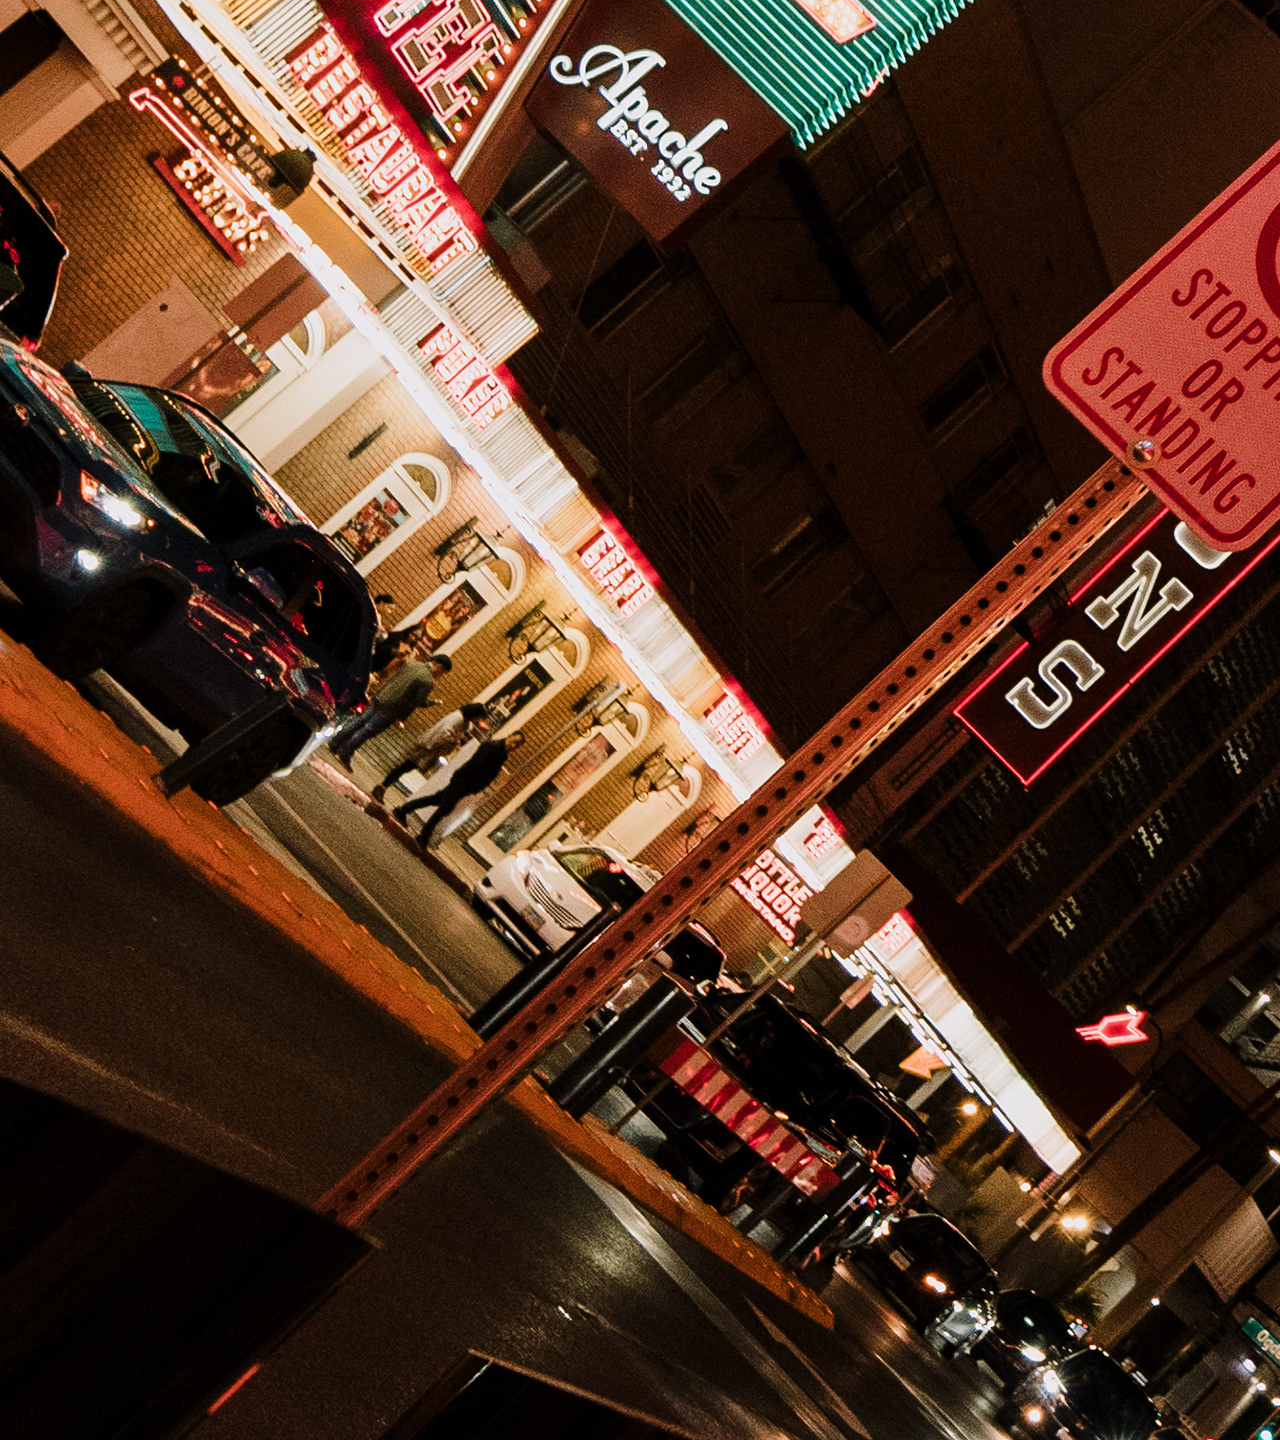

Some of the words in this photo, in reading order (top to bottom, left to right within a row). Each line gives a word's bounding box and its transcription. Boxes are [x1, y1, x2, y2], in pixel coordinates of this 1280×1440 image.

[183, 85, 241, 147] BINION'S
[236, 143, 275, 181] CAFE
[288, 26, 479, 275] RESTAURANT
[550, 44, 728, 195] Apache
[651, 159, 692, 202] 1932
[419, 325, 514, 432] POKER
[1180, 358, 1246, 423] OR
[1081, 345, 1257, 515] STANDING
[740, 863, 802, 928] IQUOR
[754, 848, 814, 907] OTTLE
